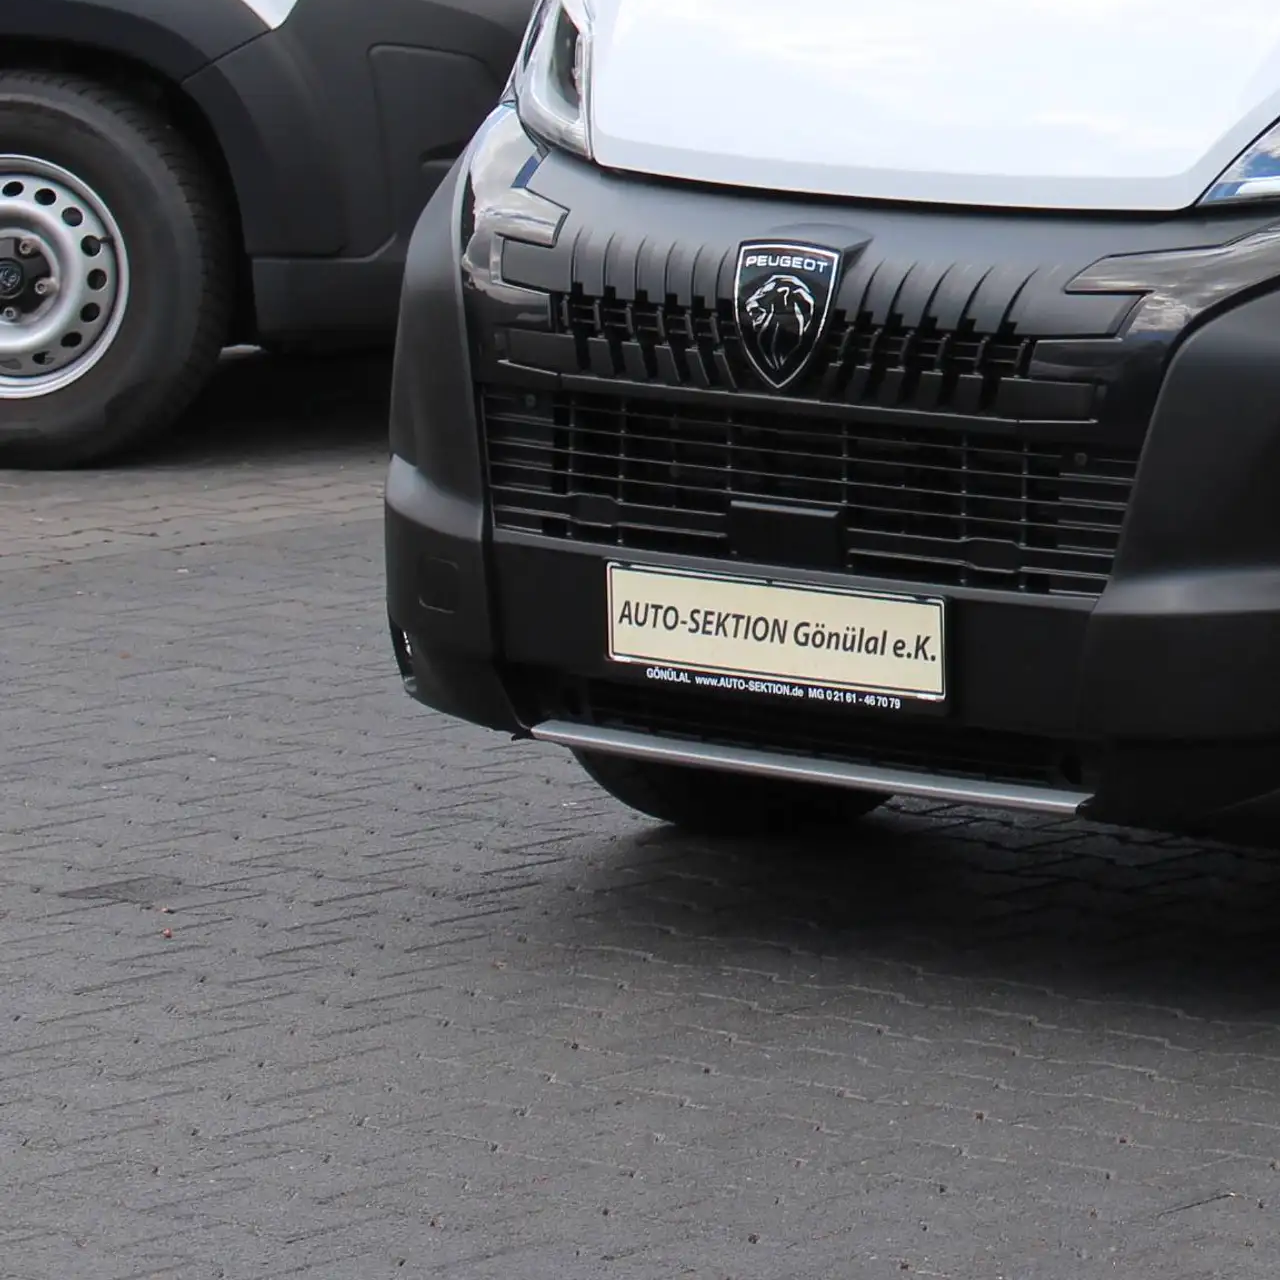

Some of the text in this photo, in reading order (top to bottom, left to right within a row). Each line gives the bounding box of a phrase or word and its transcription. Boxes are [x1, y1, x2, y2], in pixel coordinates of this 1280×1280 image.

[746, 255, 828, 272] PEUGEOT
[618, 600, 937, 662] AUTO-SEKTION Gönülal e.K.
[646, 667, 691, 683] GÖNÜLAL
[695, 676, 804, 697] www.AUTO-SEKTION.de
[808, 688, 825, 699] MG
